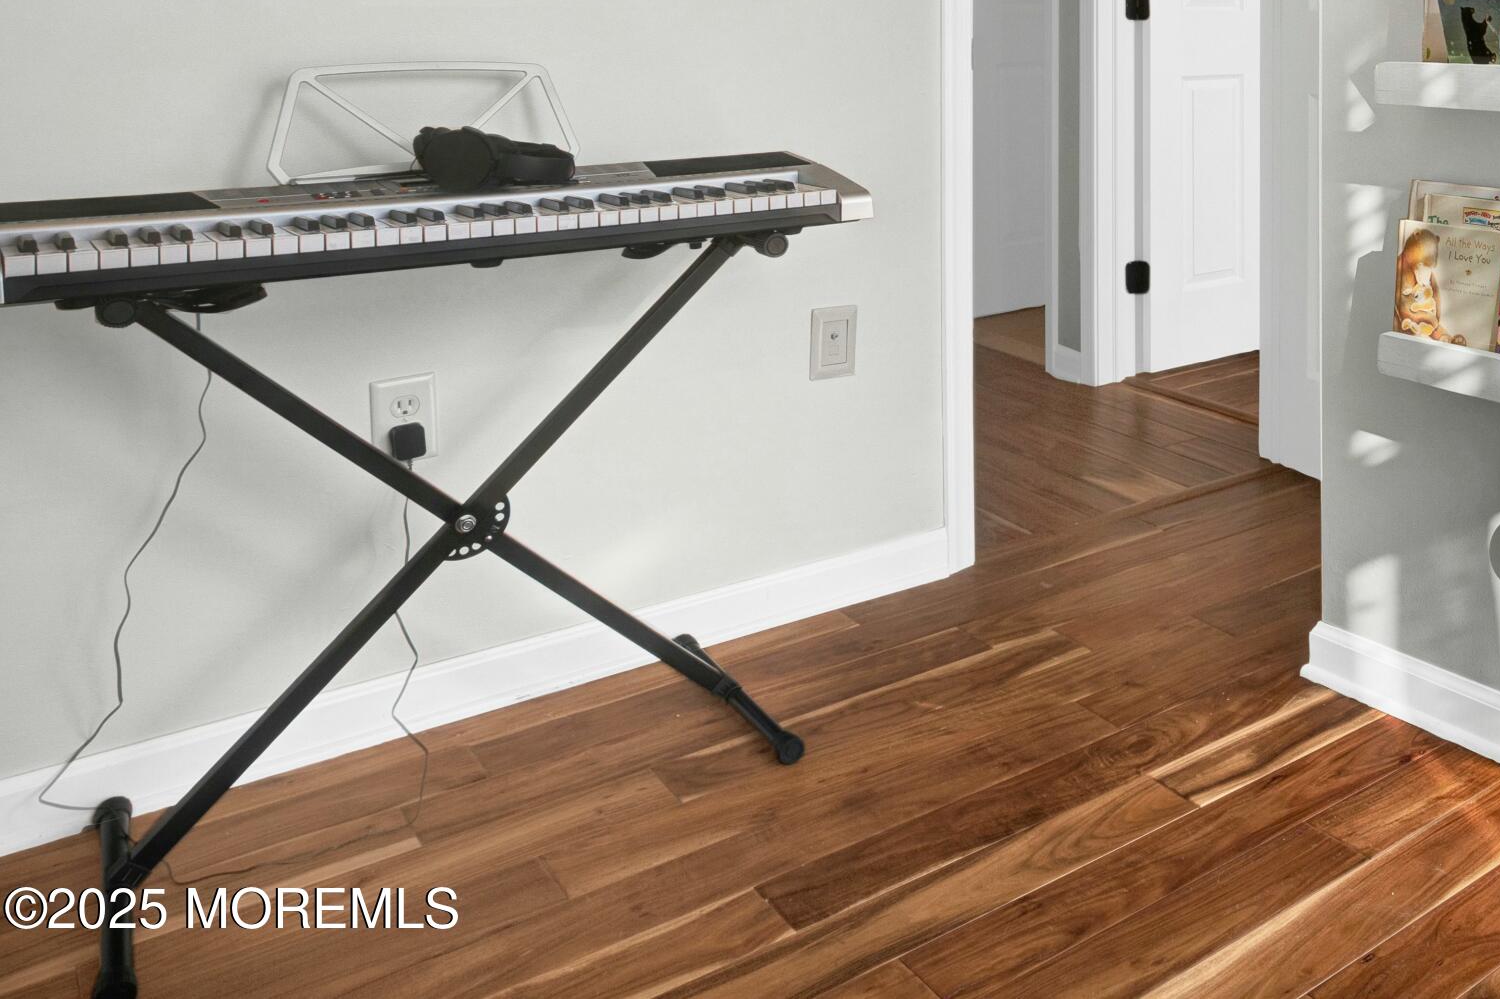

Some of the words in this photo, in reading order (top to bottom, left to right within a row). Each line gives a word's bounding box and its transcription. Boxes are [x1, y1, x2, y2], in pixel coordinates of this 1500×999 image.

[1445, 237, 1457, 247] All
[1459, 239, 1471, 249] the
[1474, 240, 1496, 254] Ways
[1454, 251, 1474, 263] Love
[1476, 254, 1491, 264] You
